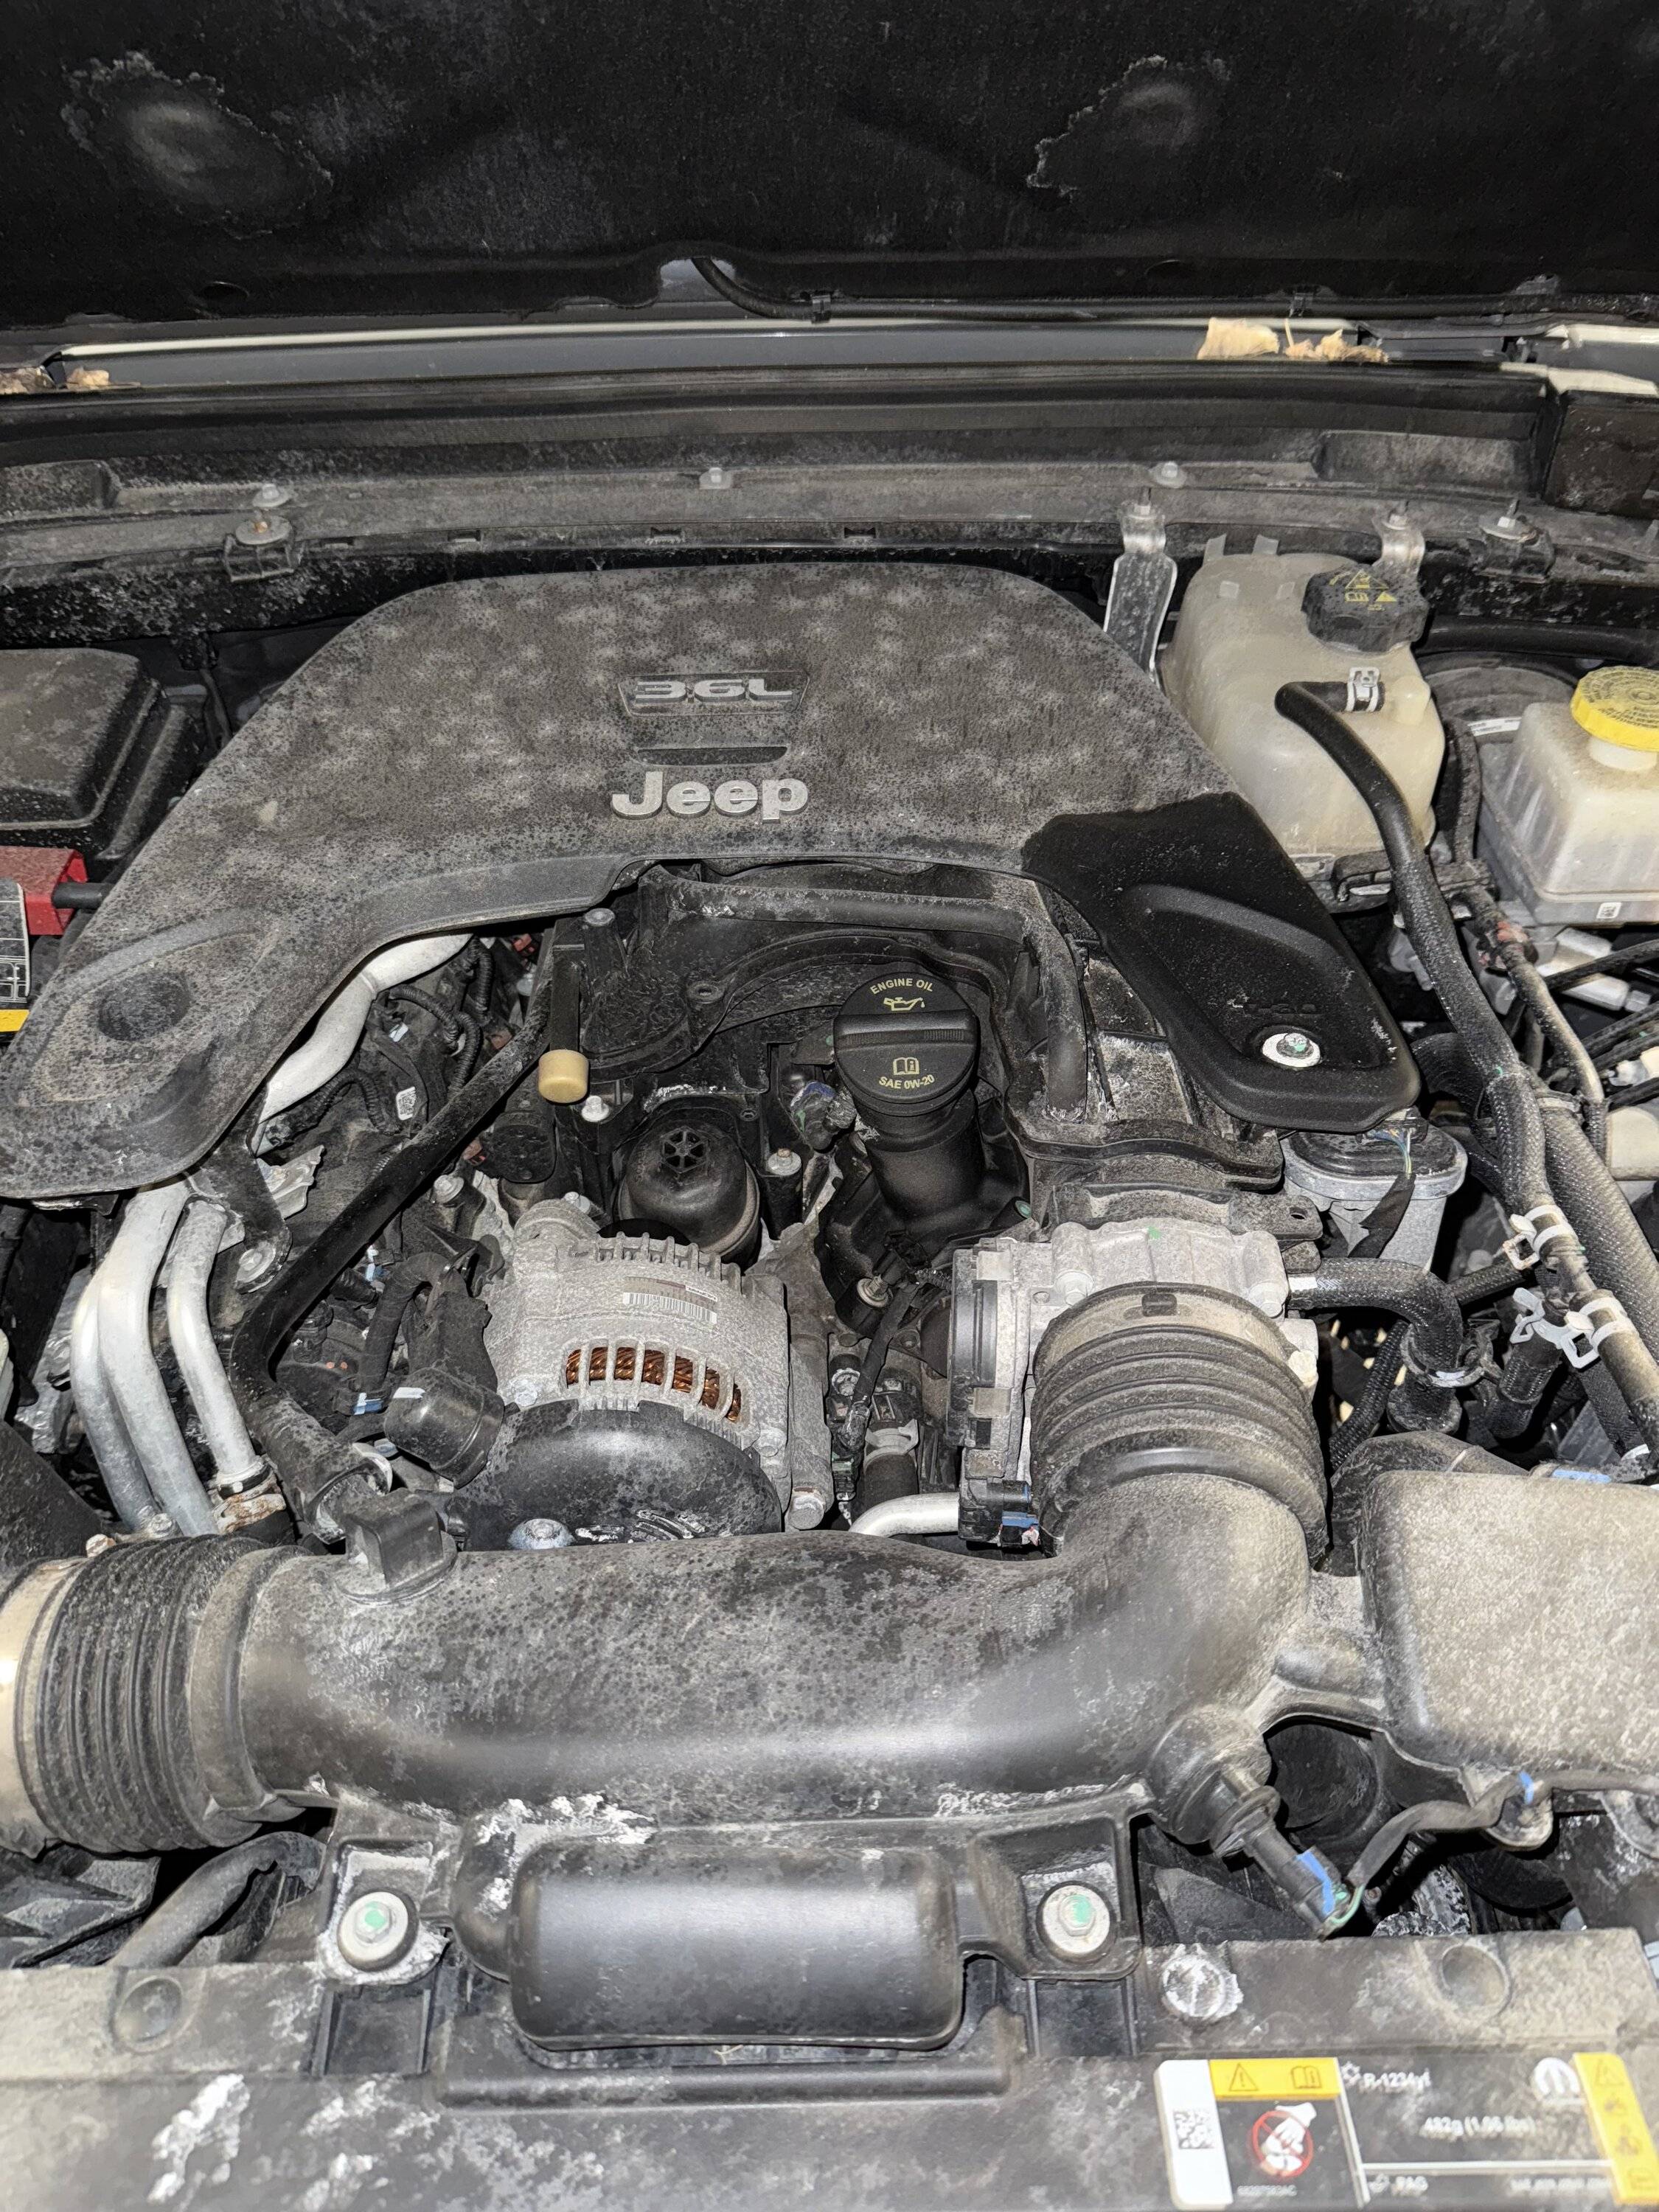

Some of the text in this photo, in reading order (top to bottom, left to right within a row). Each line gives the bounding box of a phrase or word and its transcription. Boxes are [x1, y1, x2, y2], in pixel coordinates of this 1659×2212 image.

[611, 771, 808, 824] Jeep
[870, 978, 933, 994] ENGINE OIL
[879, 1074, 935, 1089] SAE 0W-20
